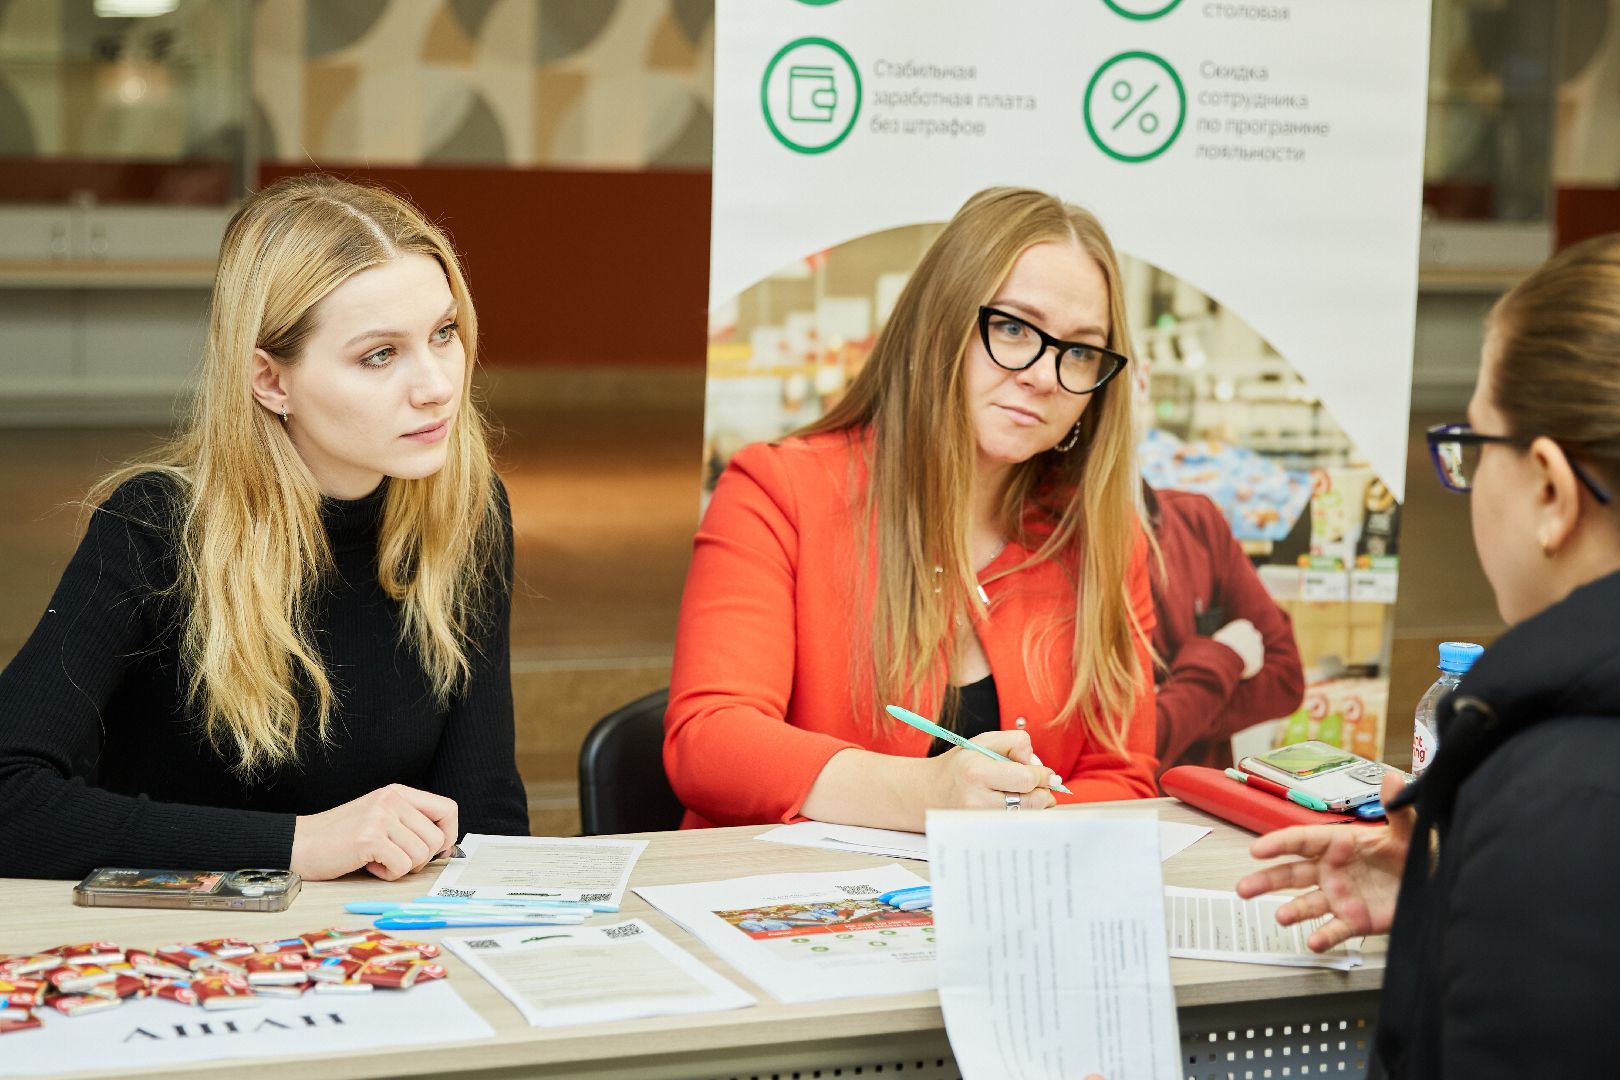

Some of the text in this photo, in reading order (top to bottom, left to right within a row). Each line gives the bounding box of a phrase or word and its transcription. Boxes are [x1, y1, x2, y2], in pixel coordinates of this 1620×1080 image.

[873, 59, 977, 80] Стабильная
[1200, 60, 1269, 81] Скидка
[872, 88, 1037, 111] заработная плата
[1198, 91, 1309, 110] сотрудника
[870, 115, 986, 137] без штрафов
[1197, 118, 1330, 138] по программе
[1195, 144, 1306, 162] лояльности
